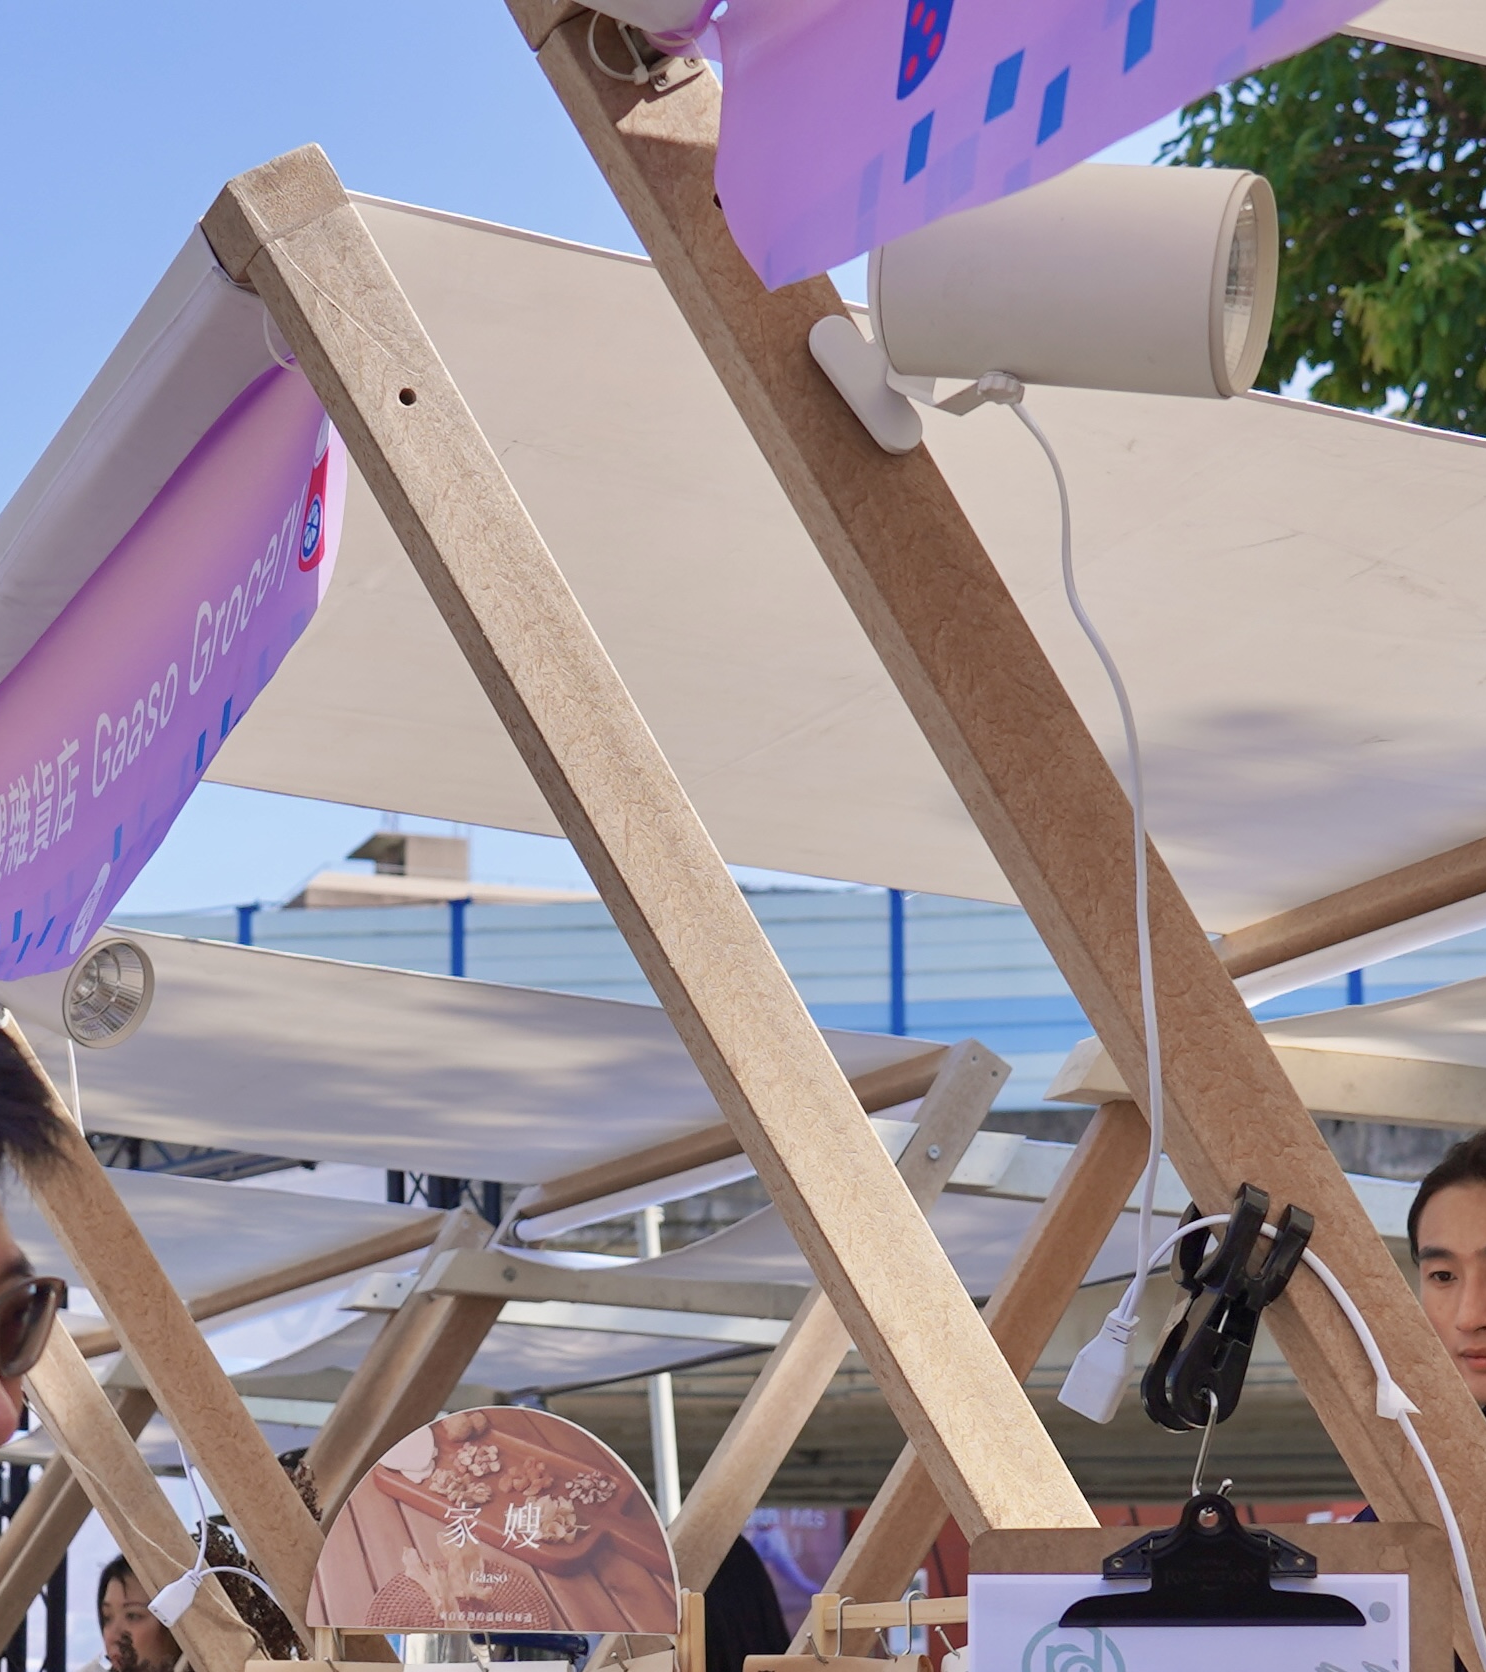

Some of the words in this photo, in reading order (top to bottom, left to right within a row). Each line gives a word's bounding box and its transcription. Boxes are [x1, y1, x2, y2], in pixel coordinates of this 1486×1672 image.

[92, 661, 178, 798] Gaaso
[187, 484, 308, 696] Grocery
[443, 1502, 541, 1549] 家嫂
[470, 1571, 508, 1583] Gaaso
